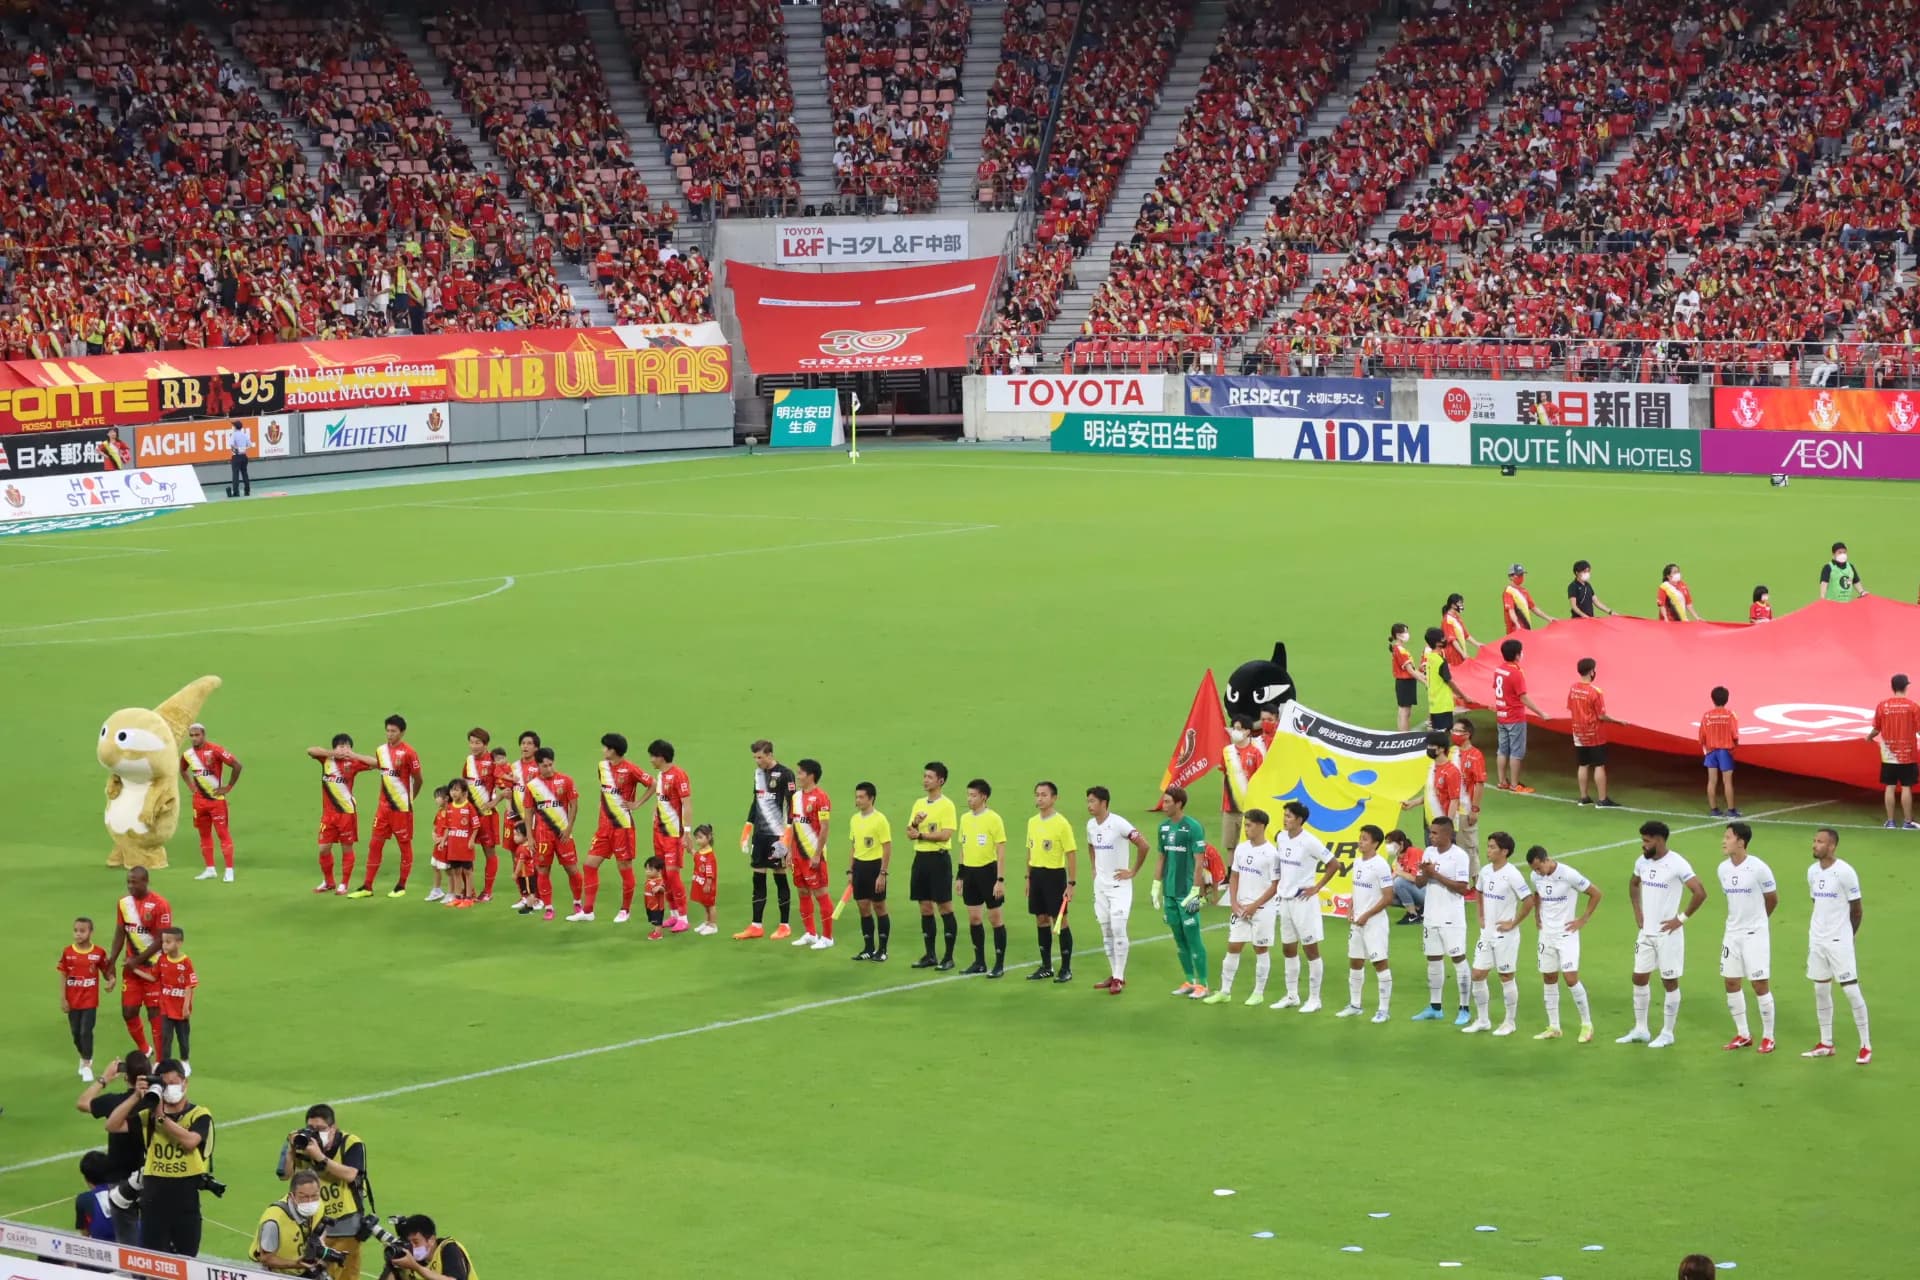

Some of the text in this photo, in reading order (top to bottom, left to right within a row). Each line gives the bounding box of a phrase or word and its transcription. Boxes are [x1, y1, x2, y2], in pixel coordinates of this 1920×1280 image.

[784, 227, 824, 236] TOYOTA
[783, 238, 824, 257] L&F
[827, 234, 961, 255] トヨタL&F中部
[798, 355, 923, 366] GRAMPUS
[287, 361, 436, 384] All day we dream
[554, 346, 728, 398] ULTRAS
[161, 378, 203, 409] RB
[287, 389, 336, 406] about
[339, 383, 411, 401] NAGOYA
[1007, 379, 1144, 407] TOYOTA
[1228, 387, 1302, 406] RESPECT
[1306, 393, 1365, 405] 大切に思うこと
[776, 405, 832, 419] 明治安田
[1516, 390, 1672, 428] 朝日新聞
[322, 413, 407, 449] MEITETSU
[788, 421, 817, 434] 生命
[1083, 419, 1219, 451] 明治安田生命
[140, 427, 256, 457] AICHI STEL
[1479, 437, 1560, 464] ROUTE
[1617, 447, 1692, 468] HOTELS
[1495, 675, 1504, 698] 8
[1318, 726, 1373, 749] 明治安田生命
[154, 1143, 185, 1160] 005
[152, 1161, 187, 1173] PRESS
[320, 1183, 340, 1201] 06
[324, 1201, 344, 1215] ESS
[127, 1254, 180, 1275] AICHI STEEL
